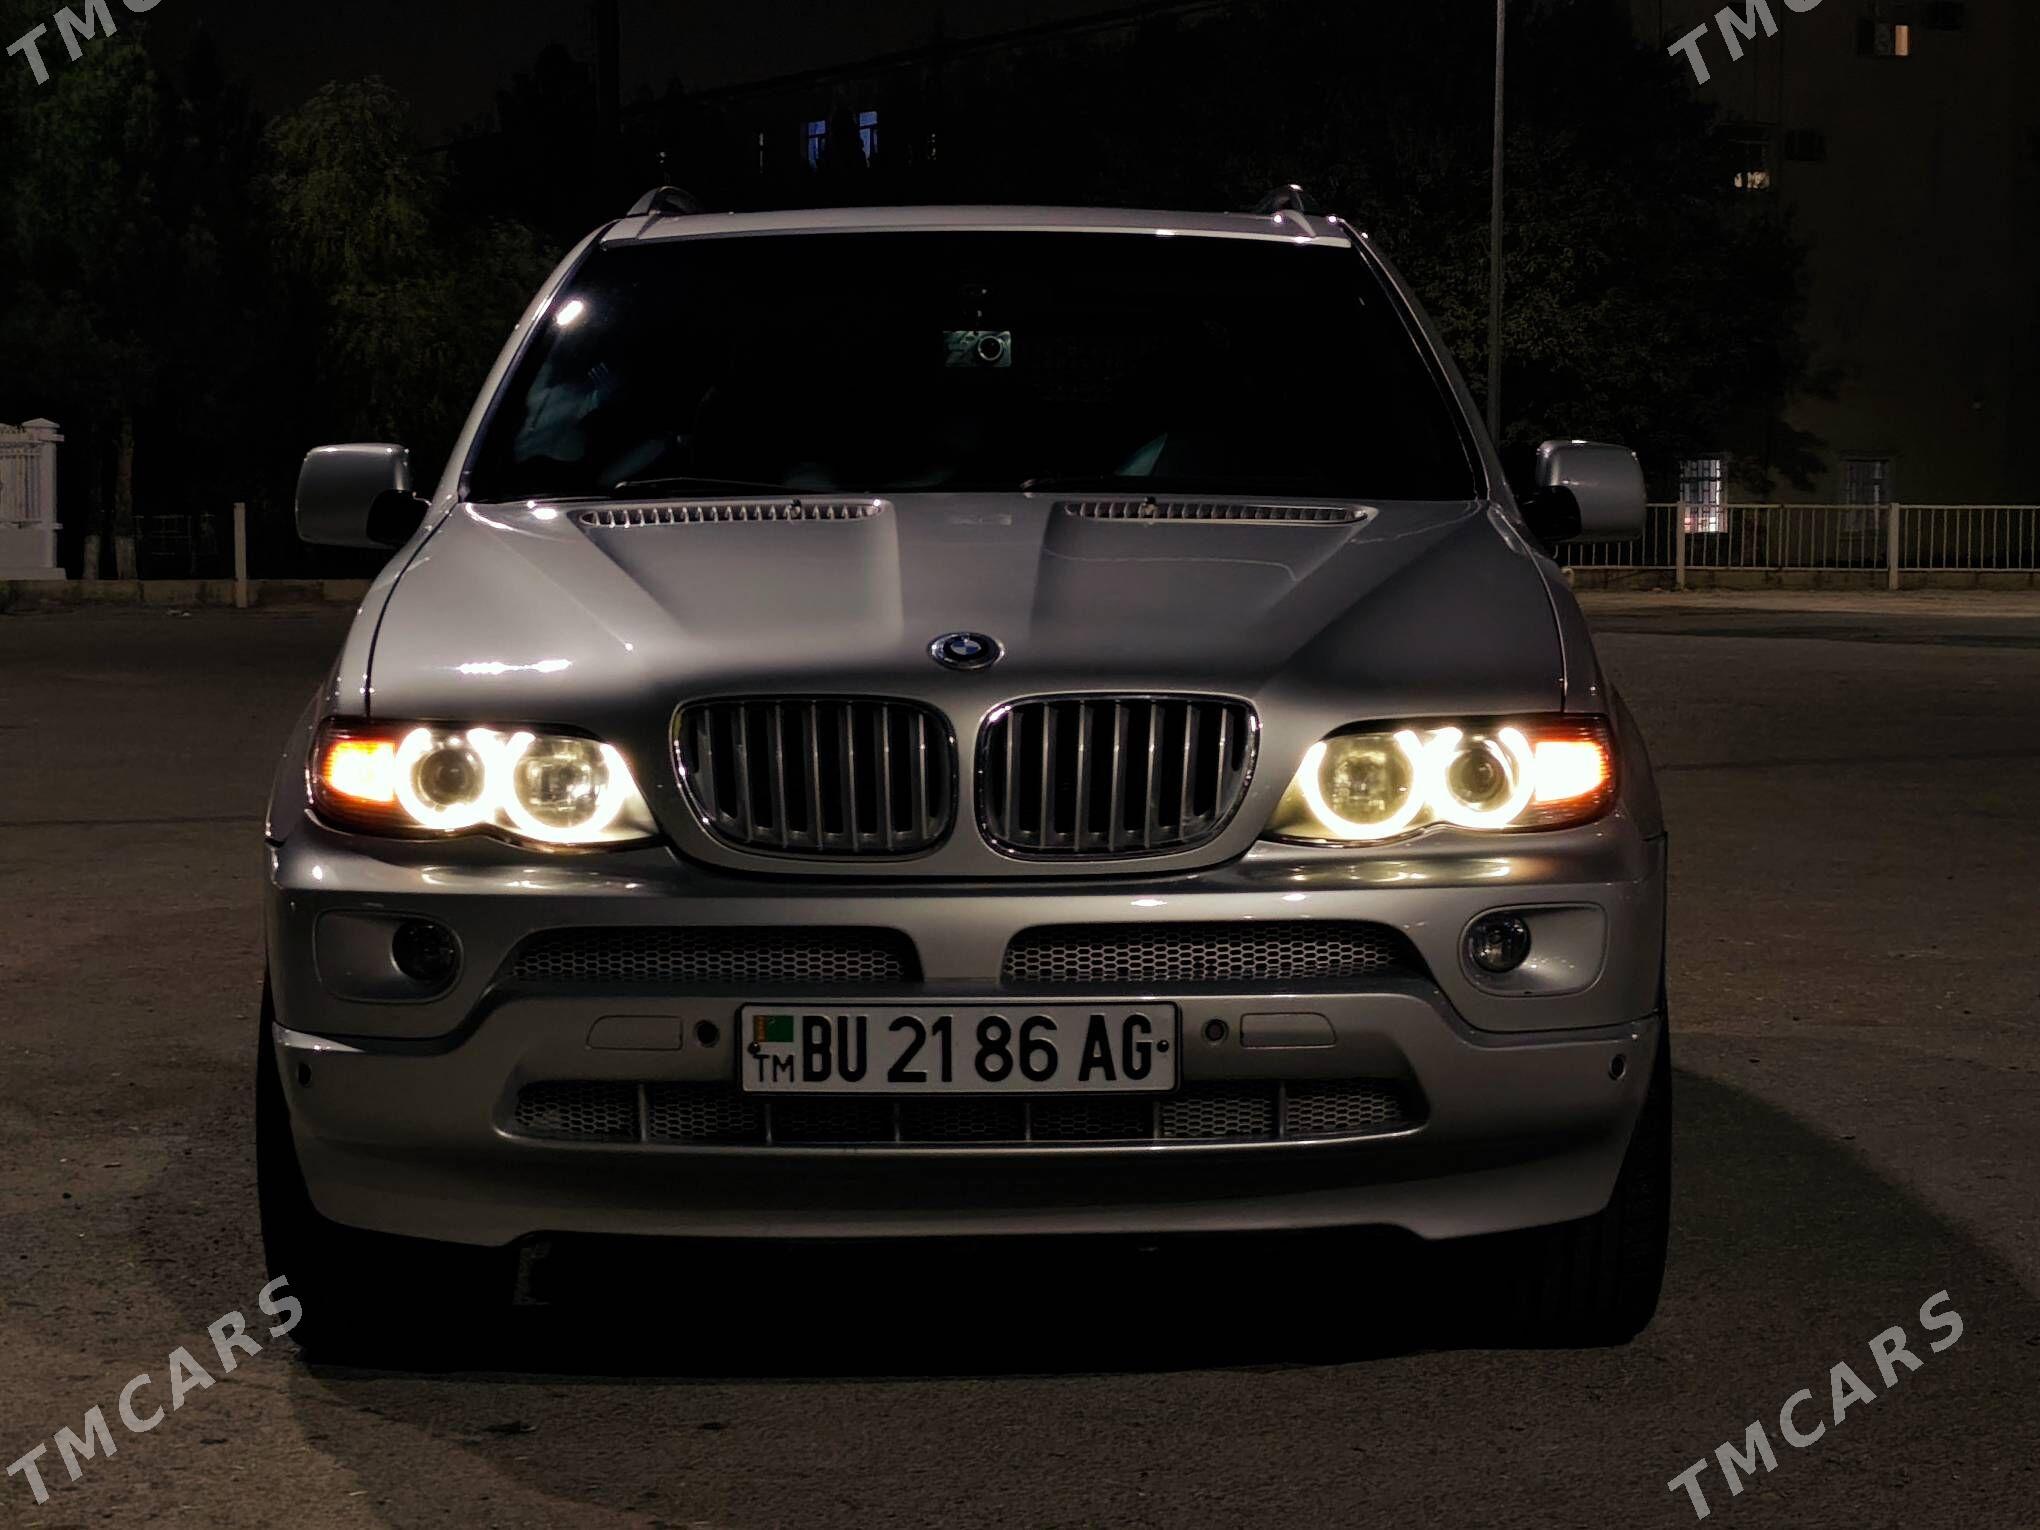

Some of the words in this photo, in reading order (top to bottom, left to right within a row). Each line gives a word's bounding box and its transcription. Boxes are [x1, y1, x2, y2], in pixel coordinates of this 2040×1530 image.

[753, 1054, 794, 1082] TM
[803, 1015, 867, 1082] BU
[888, 1015, 953, 1082] 21
[975, 1015, 1058, 1082] 86
[1078, 1014, 1152, 1082] AG
